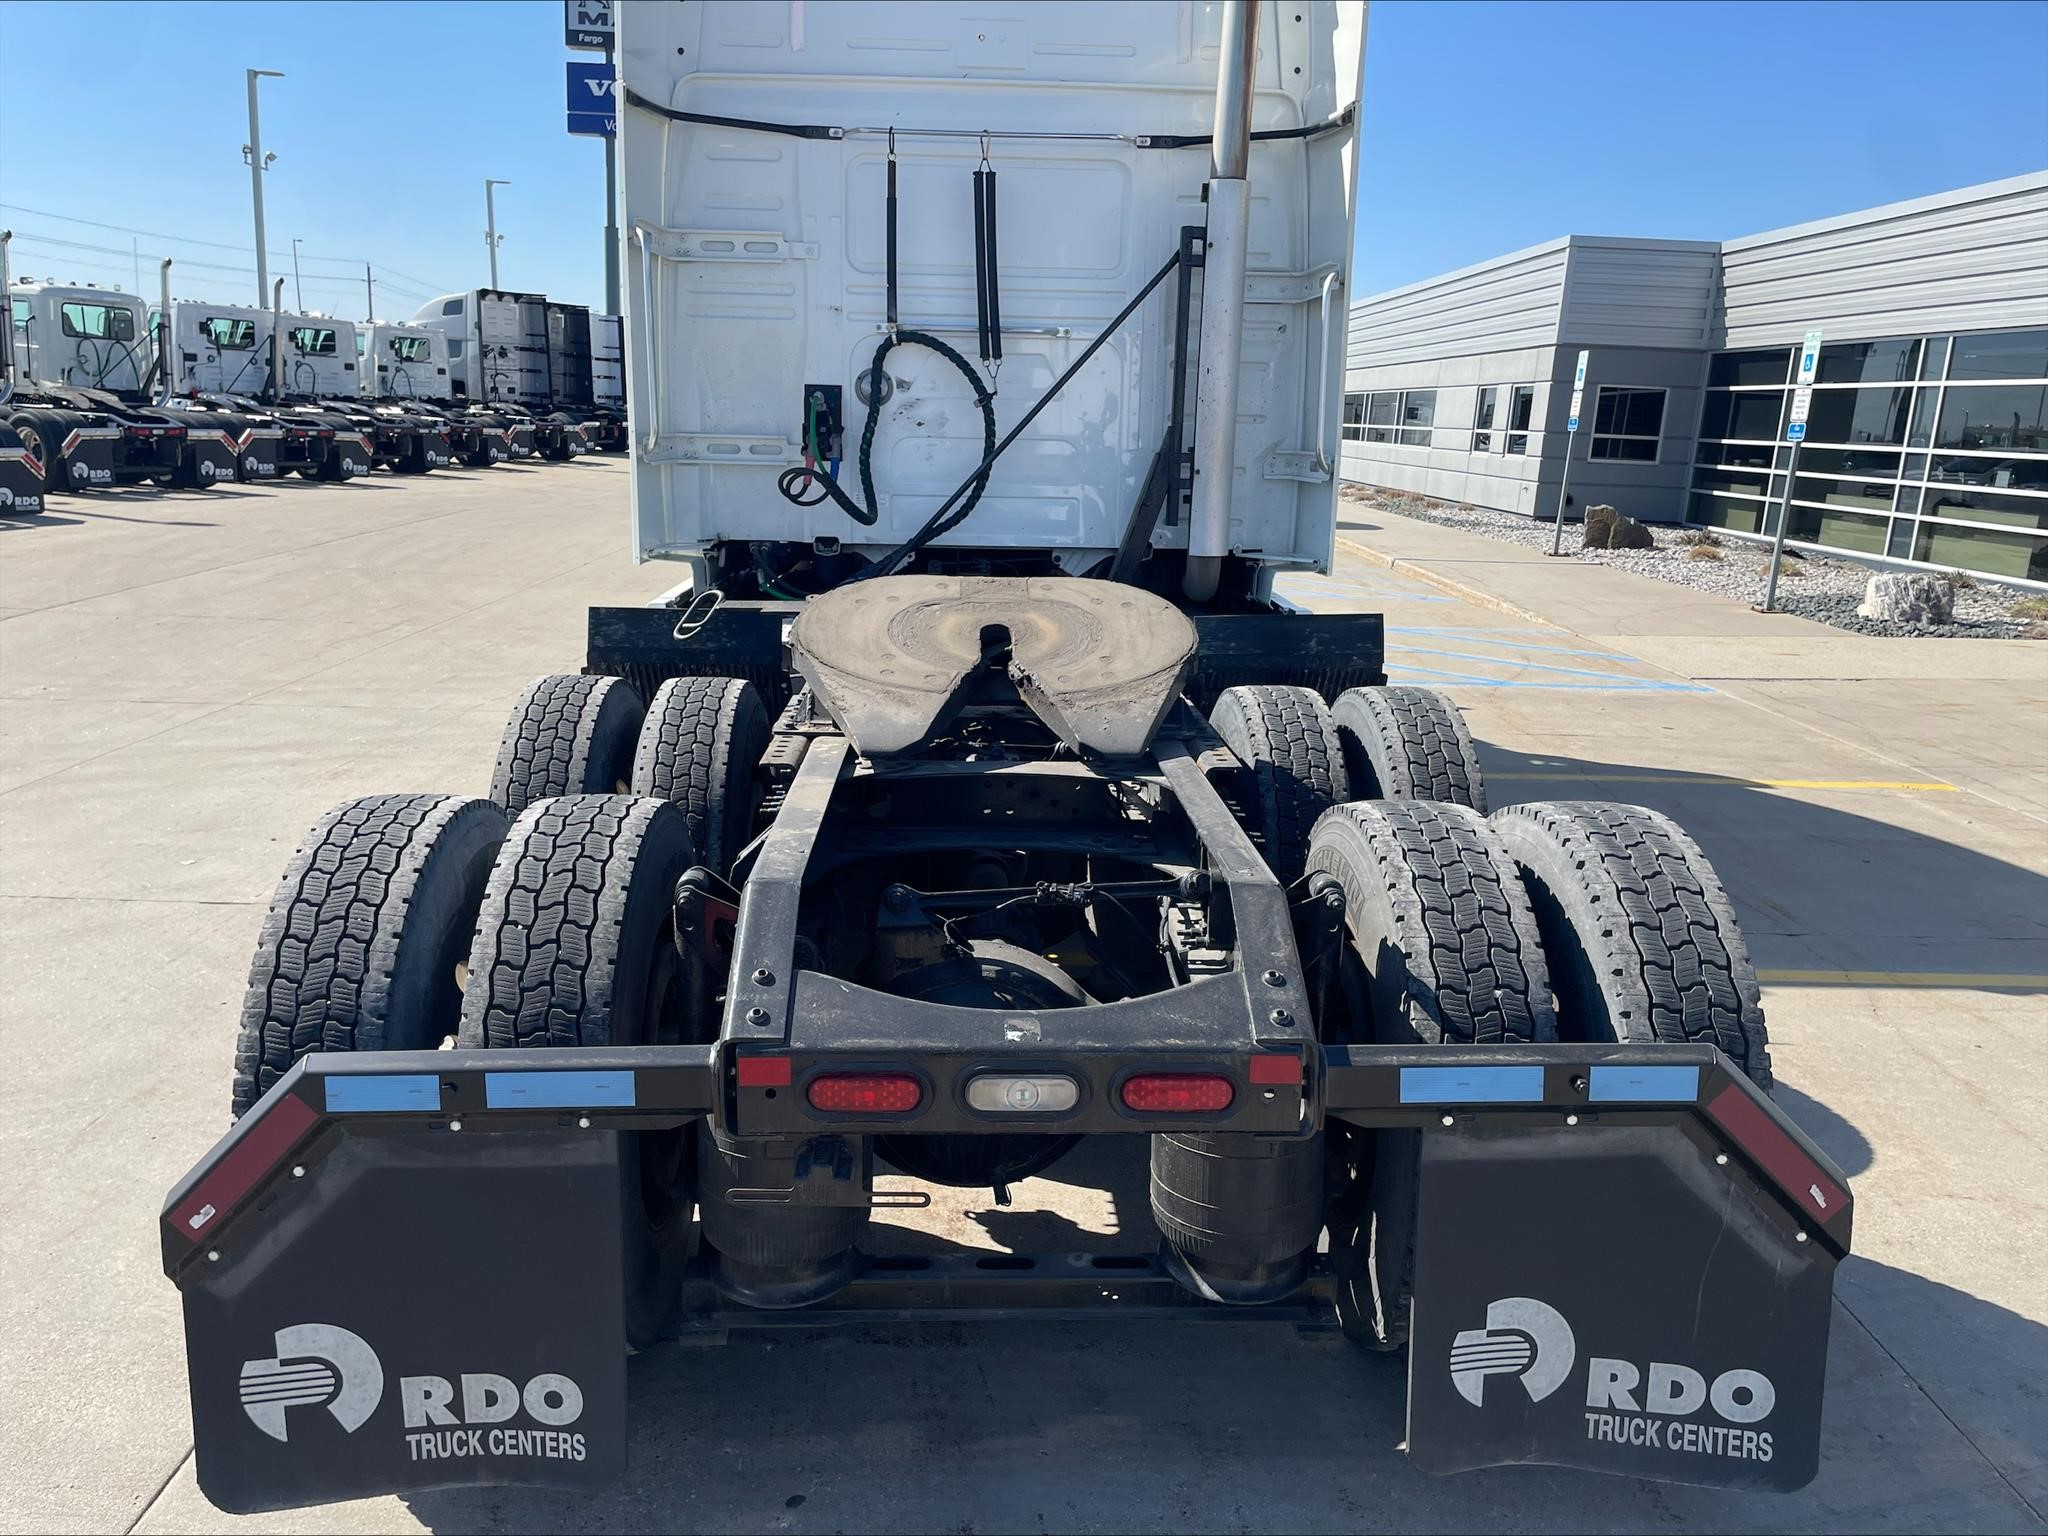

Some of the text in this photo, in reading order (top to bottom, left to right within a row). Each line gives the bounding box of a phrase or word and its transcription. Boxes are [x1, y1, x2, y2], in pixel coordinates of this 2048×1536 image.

[578, 11, 615, 27] M
[579, 33, 603, 44] Fargo
[15, 496, 40, 506] RDO
[400, 1373, 584, 1429] RDO
[1586, 1357, 1776, 1424] RDO
[406, 1429, 586, 1462] TRUCK CENTERS
[1585, 1413, 1774, 1462] TRUCK CENTERS
